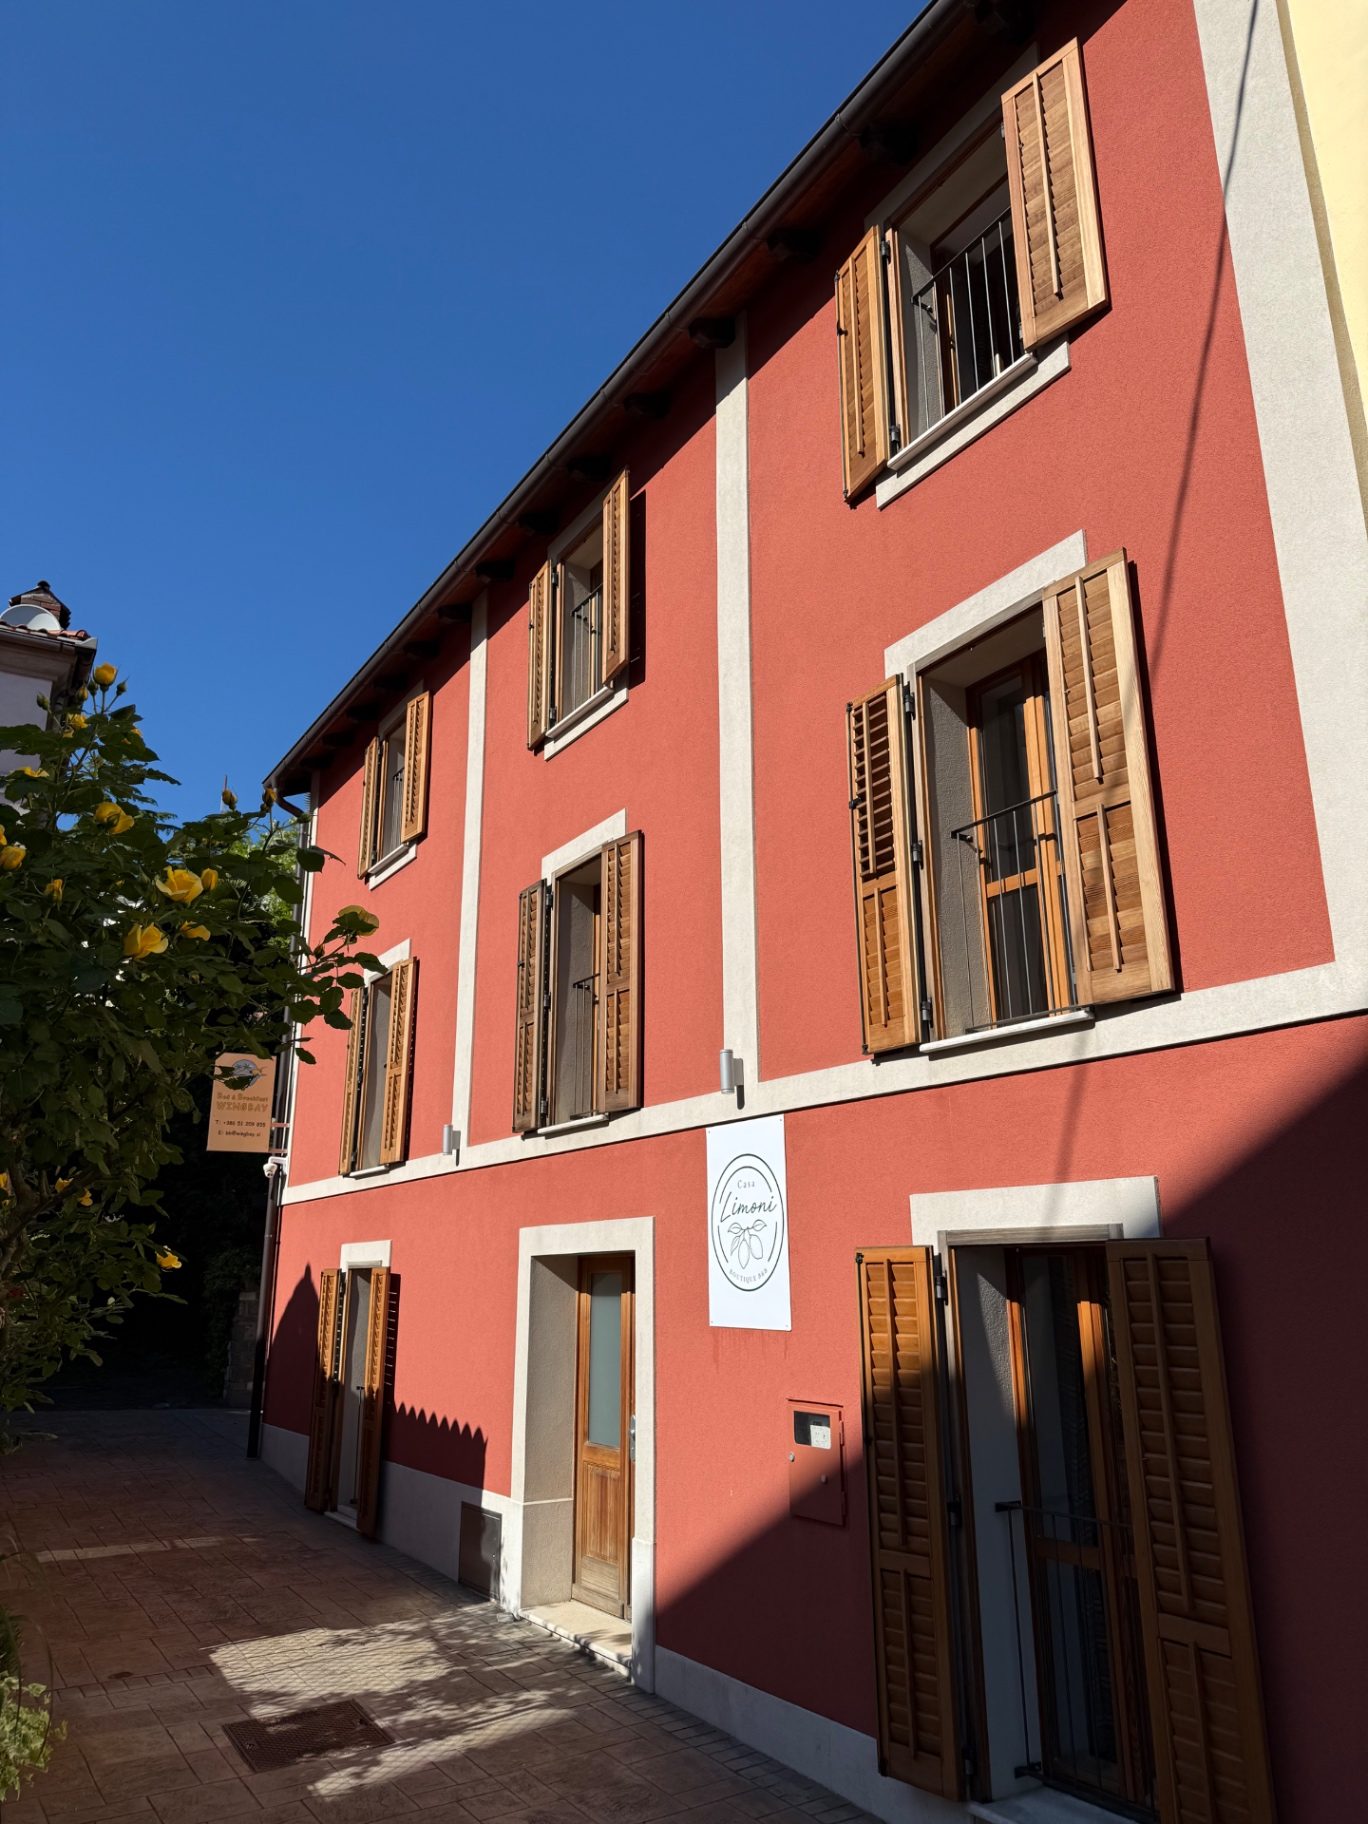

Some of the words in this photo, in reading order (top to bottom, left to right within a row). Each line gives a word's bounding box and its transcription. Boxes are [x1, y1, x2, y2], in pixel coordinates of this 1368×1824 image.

[238, 1093, 268, 1102] Breakfast
[737, 1179, 755, 1189] Casa
[720, 1191, 777, 1222] Limoni
[729, 1269, 756, 1284] BOUTIQUE
